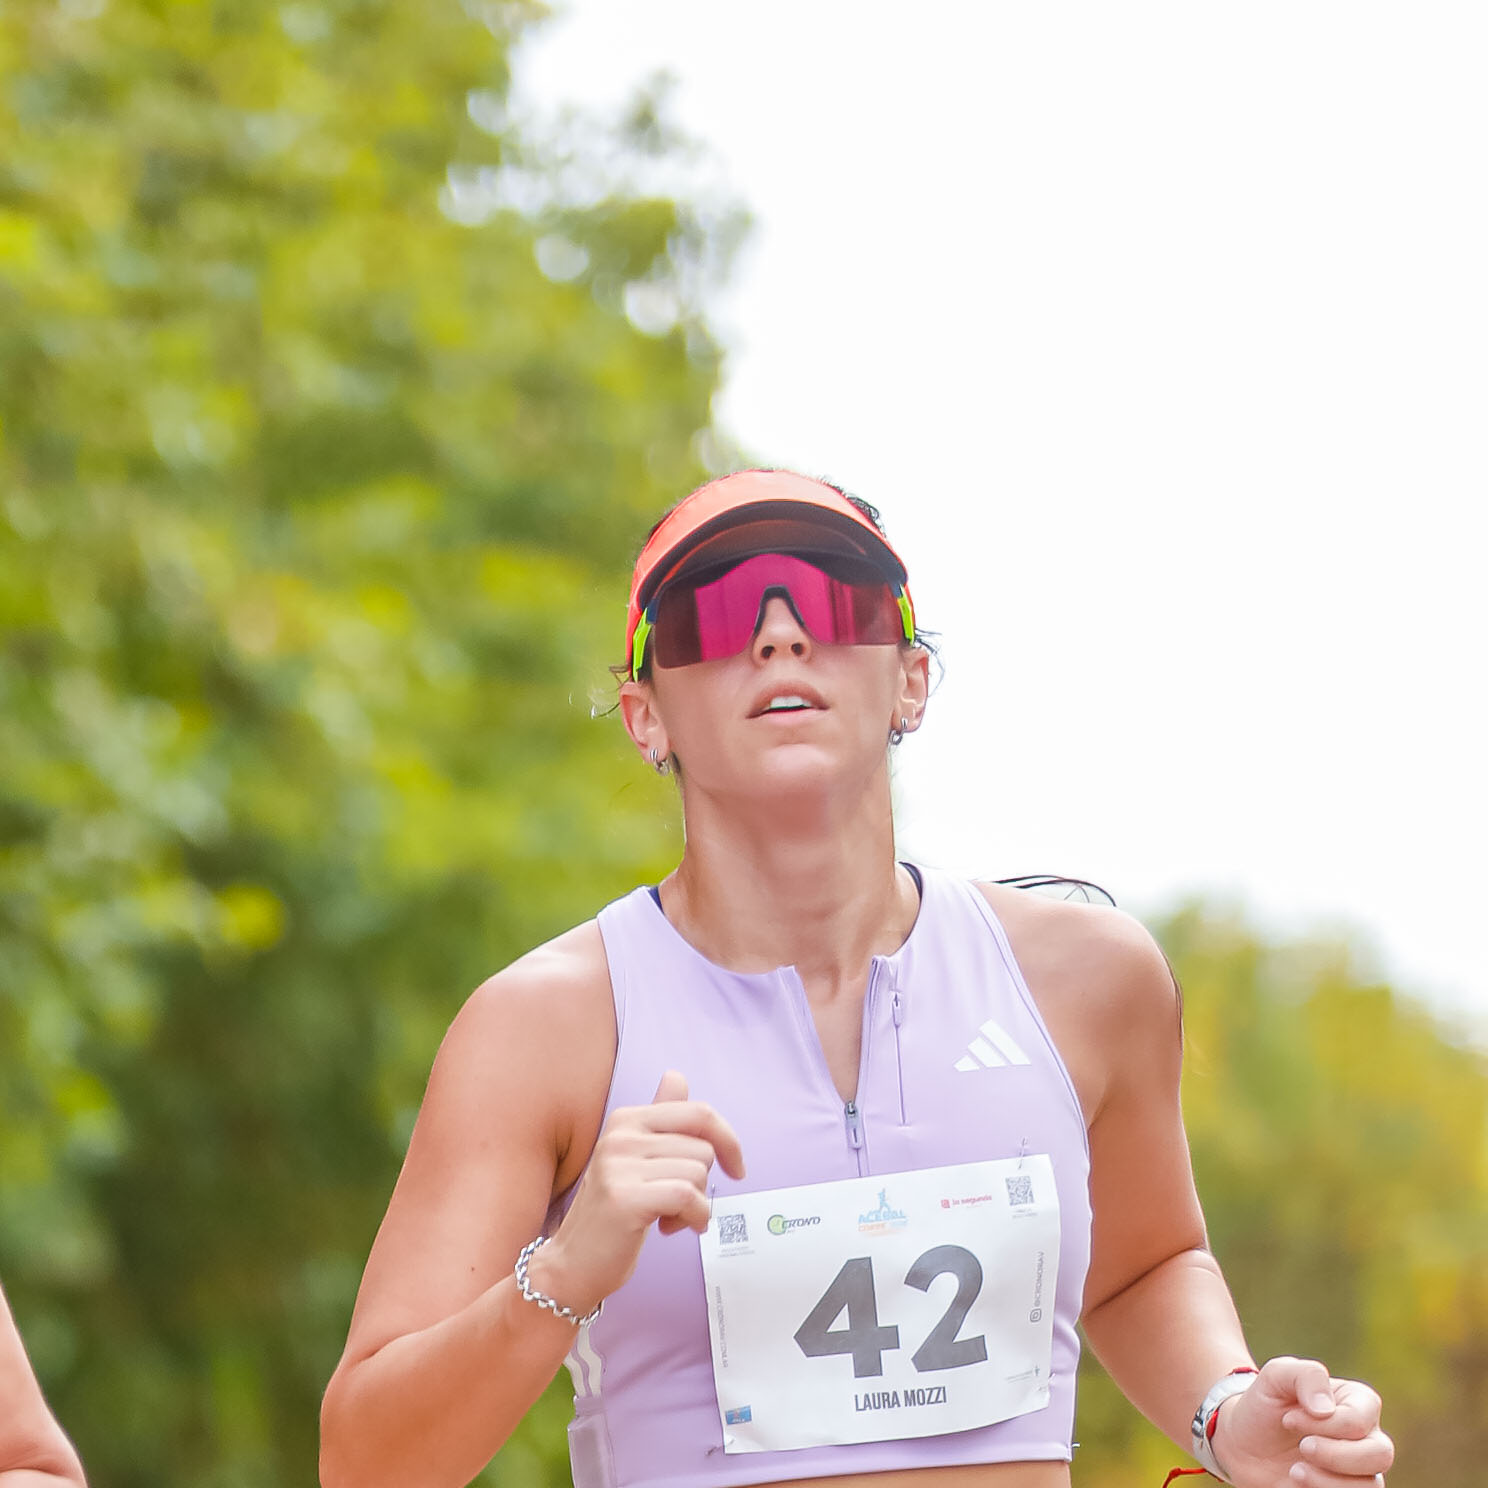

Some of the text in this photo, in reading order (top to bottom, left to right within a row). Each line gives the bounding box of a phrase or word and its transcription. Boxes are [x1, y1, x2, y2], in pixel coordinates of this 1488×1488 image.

[793, 1244, 987, 1378] 42
[854, 1385, 947, 1413] LAURA MOZZI
